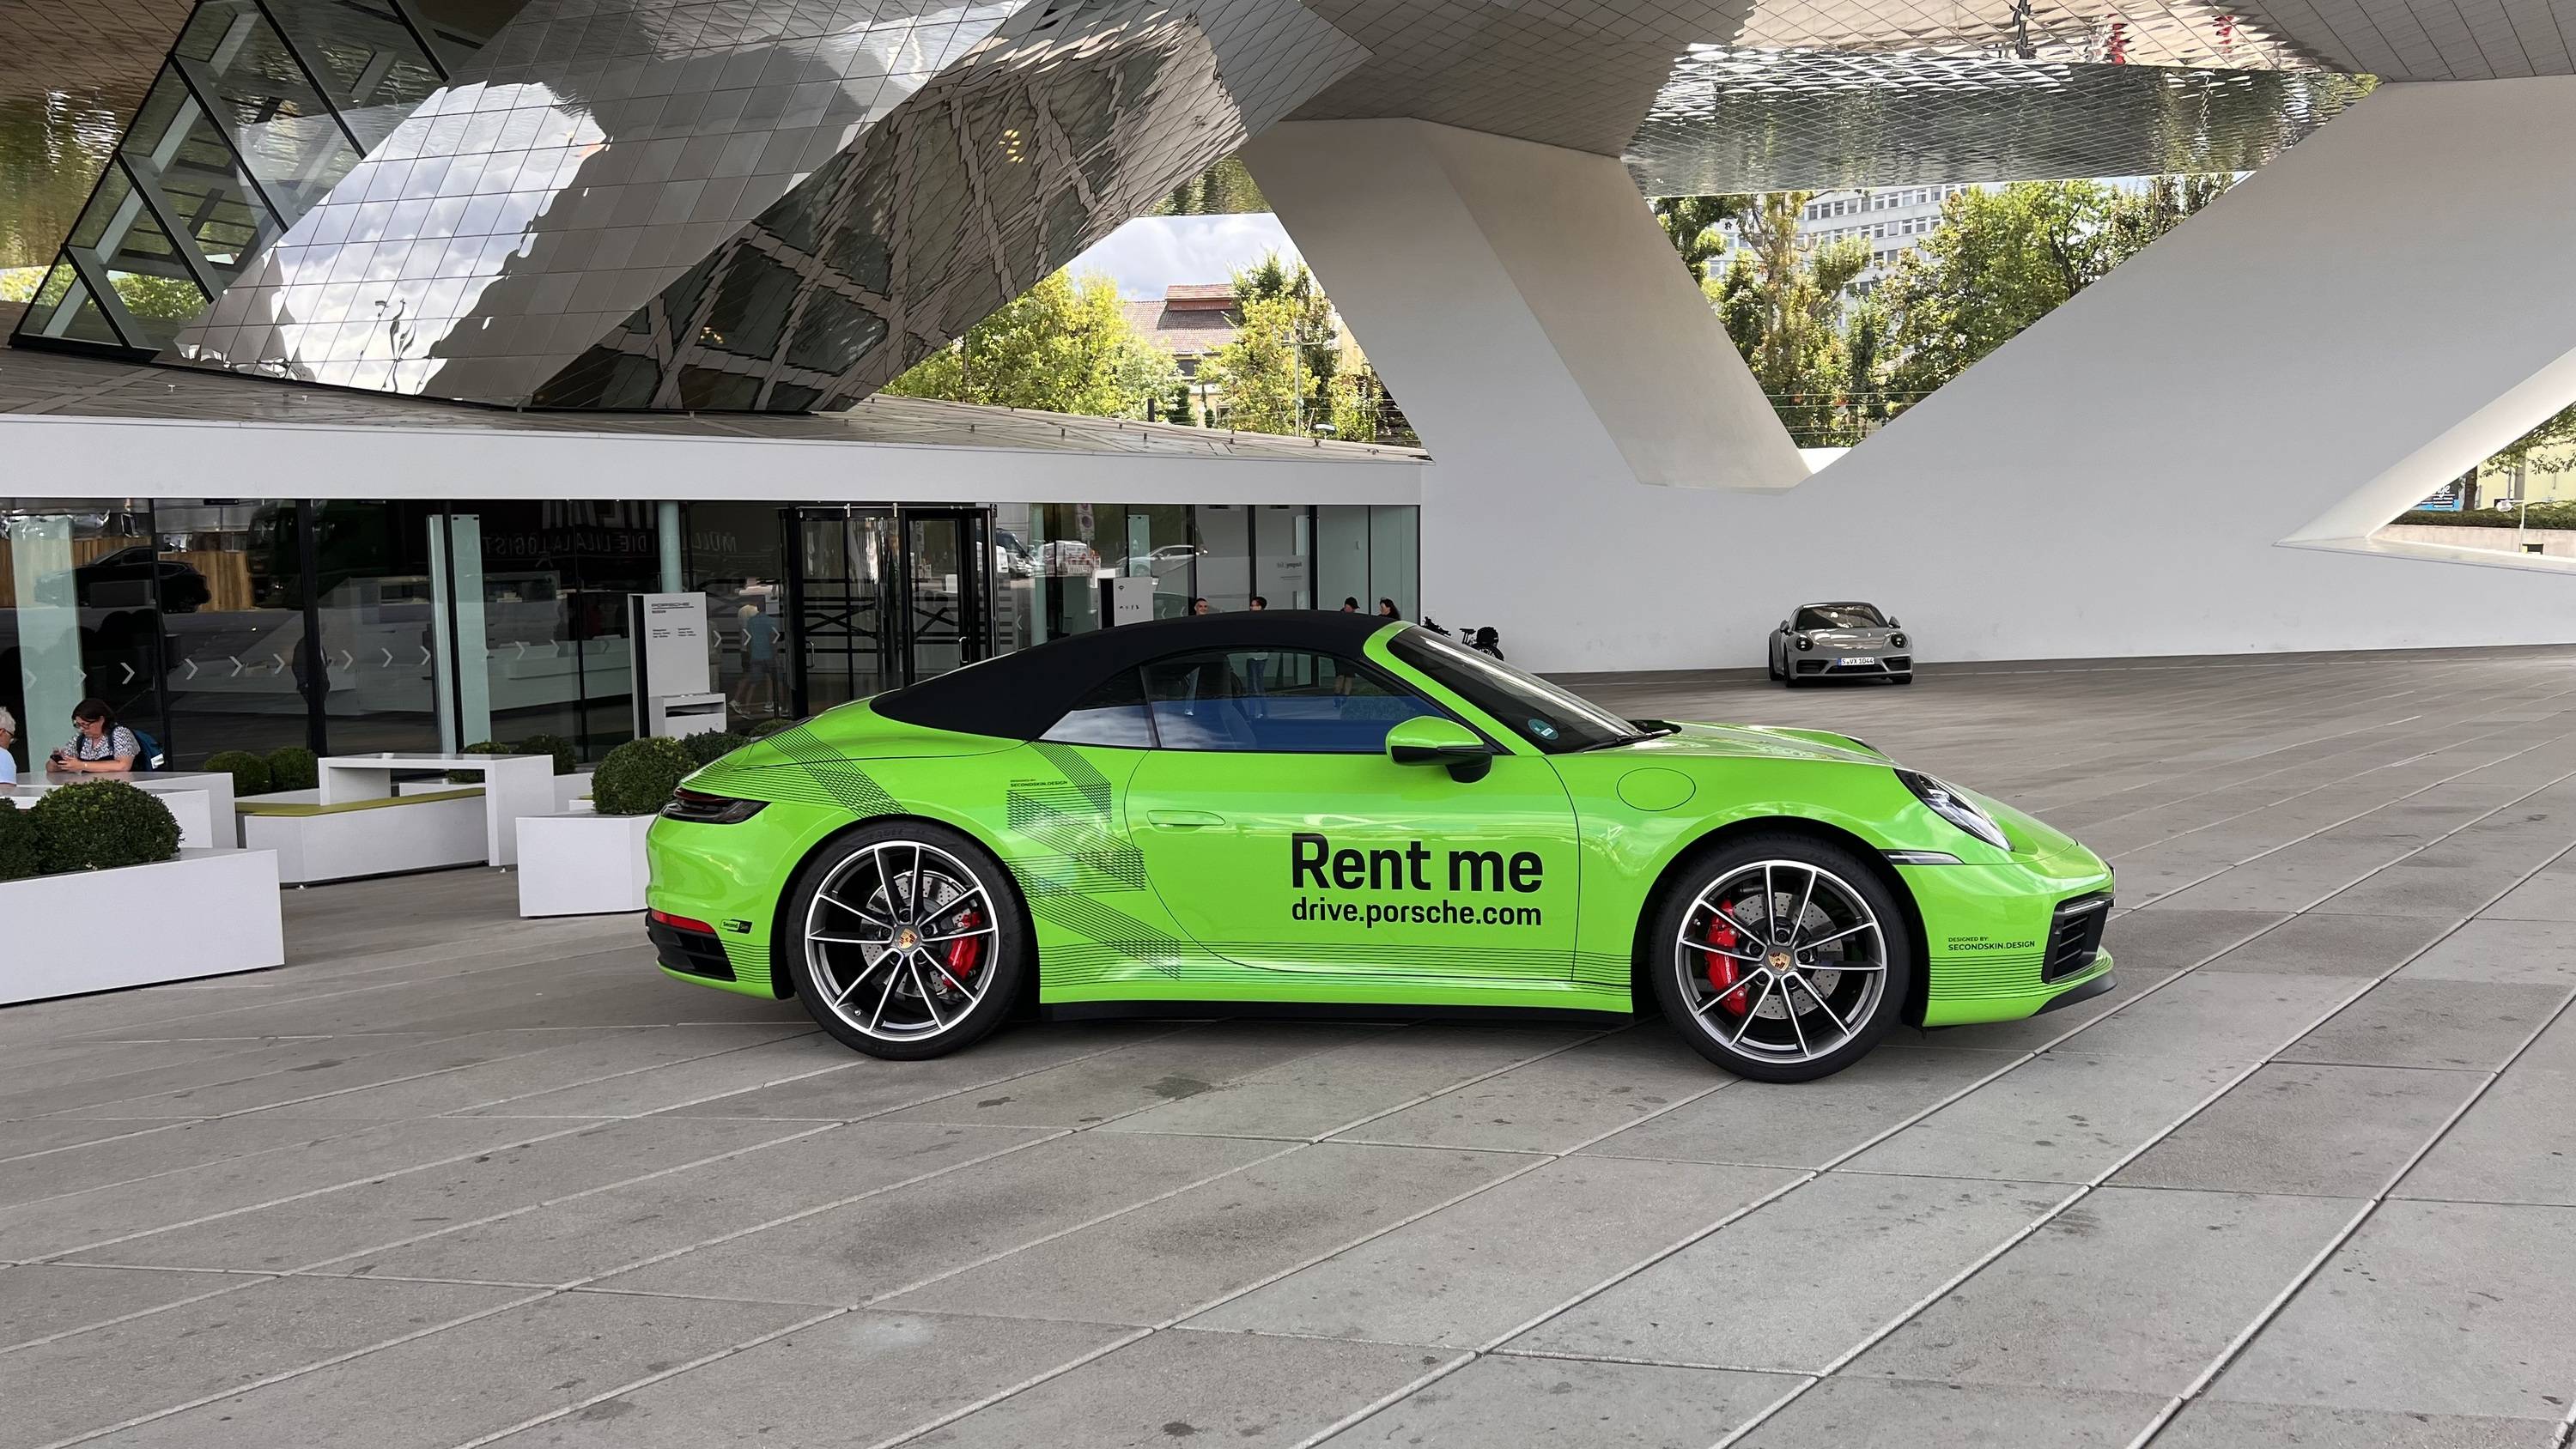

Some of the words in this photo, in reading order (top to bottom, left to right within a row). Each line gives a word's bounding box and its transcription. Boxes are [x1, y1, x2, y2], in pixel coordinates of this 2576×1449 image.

[1291, 832, 1431, 890] Rent
[1449, 849, 1544, 893] me
[1291, 896, 1542, 928] drive.porsche.com
[1948, 940, 2035, 951] SECONDSKIN.DESIGN
